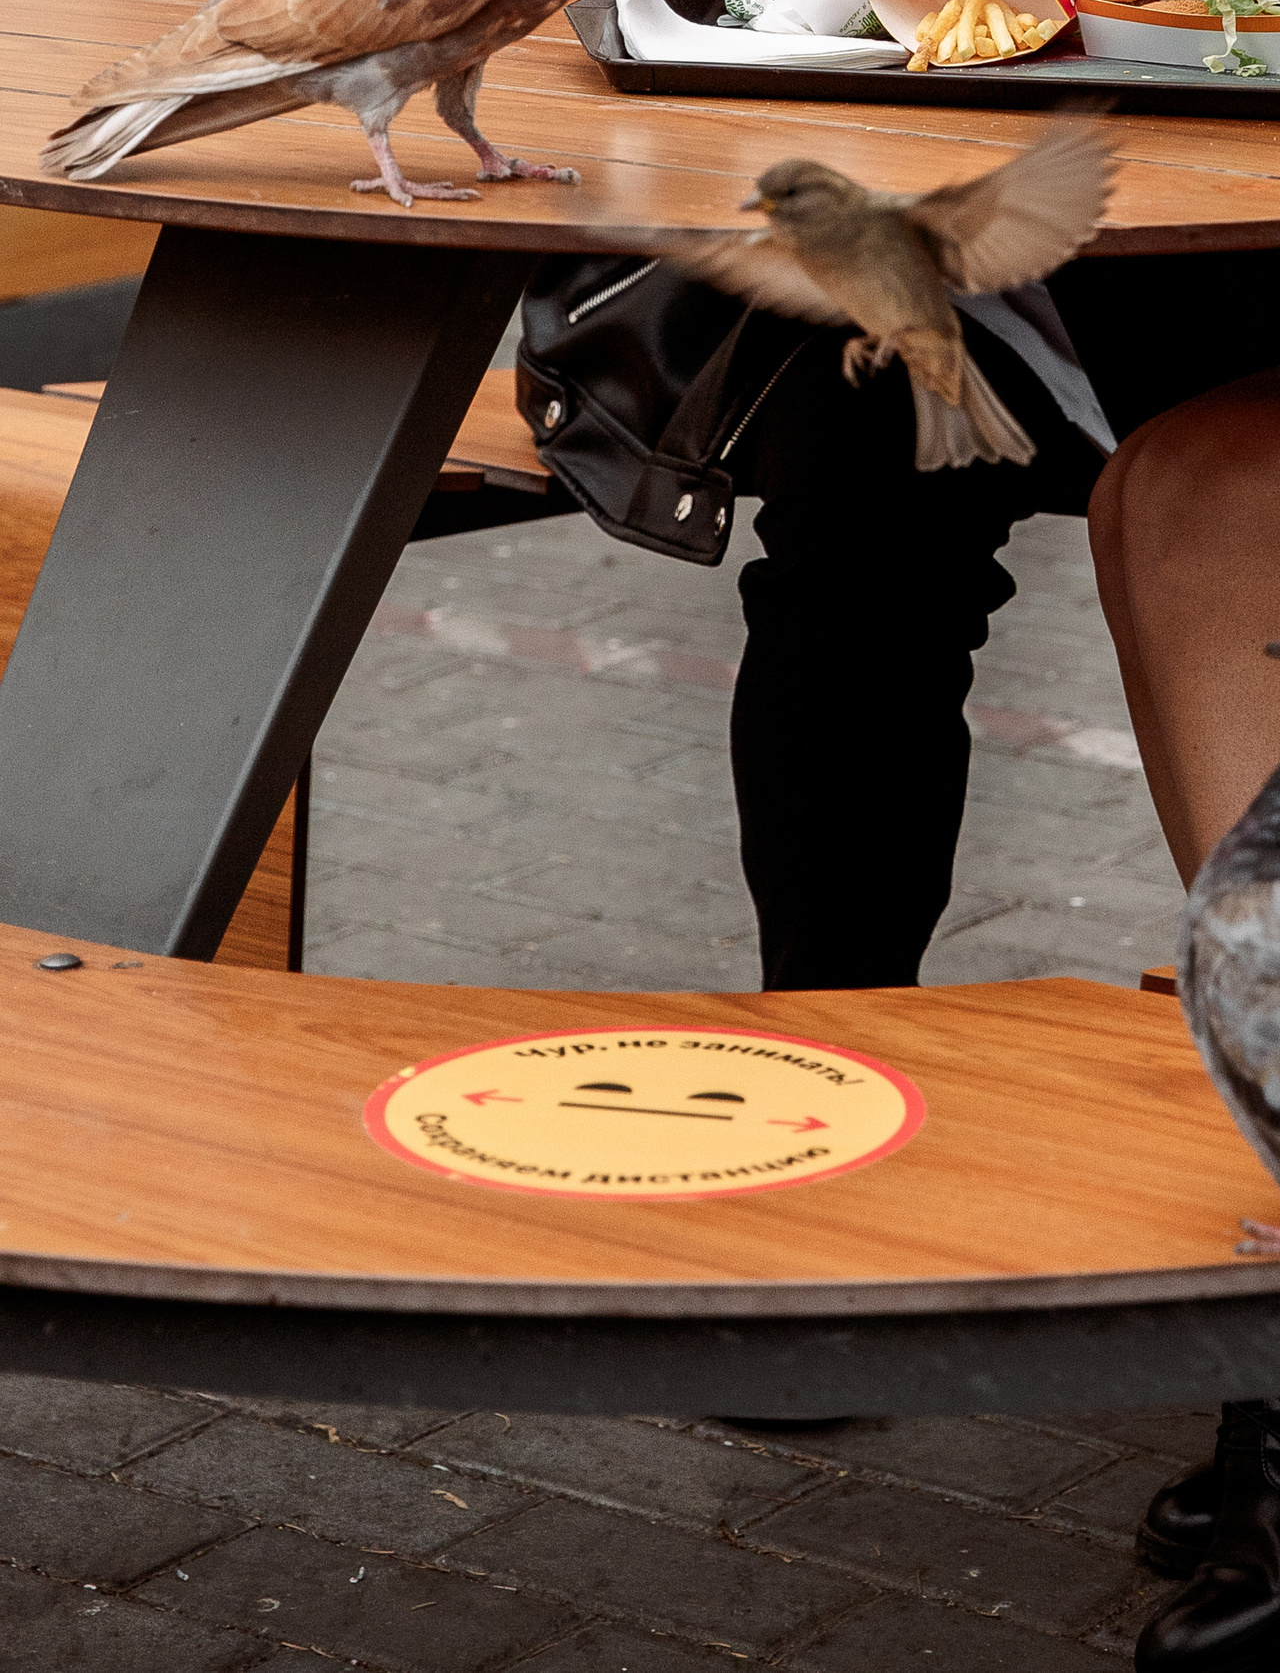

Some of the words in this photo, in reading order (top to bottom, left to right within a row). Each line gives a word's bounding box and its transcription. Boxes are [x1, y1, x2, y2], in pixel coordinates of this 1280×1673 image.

[617, 1039, 668, 1049] не
[415, 1113, 571, 1179] Сохраняем
[581, 1147, 831, 1184] дистанцию
